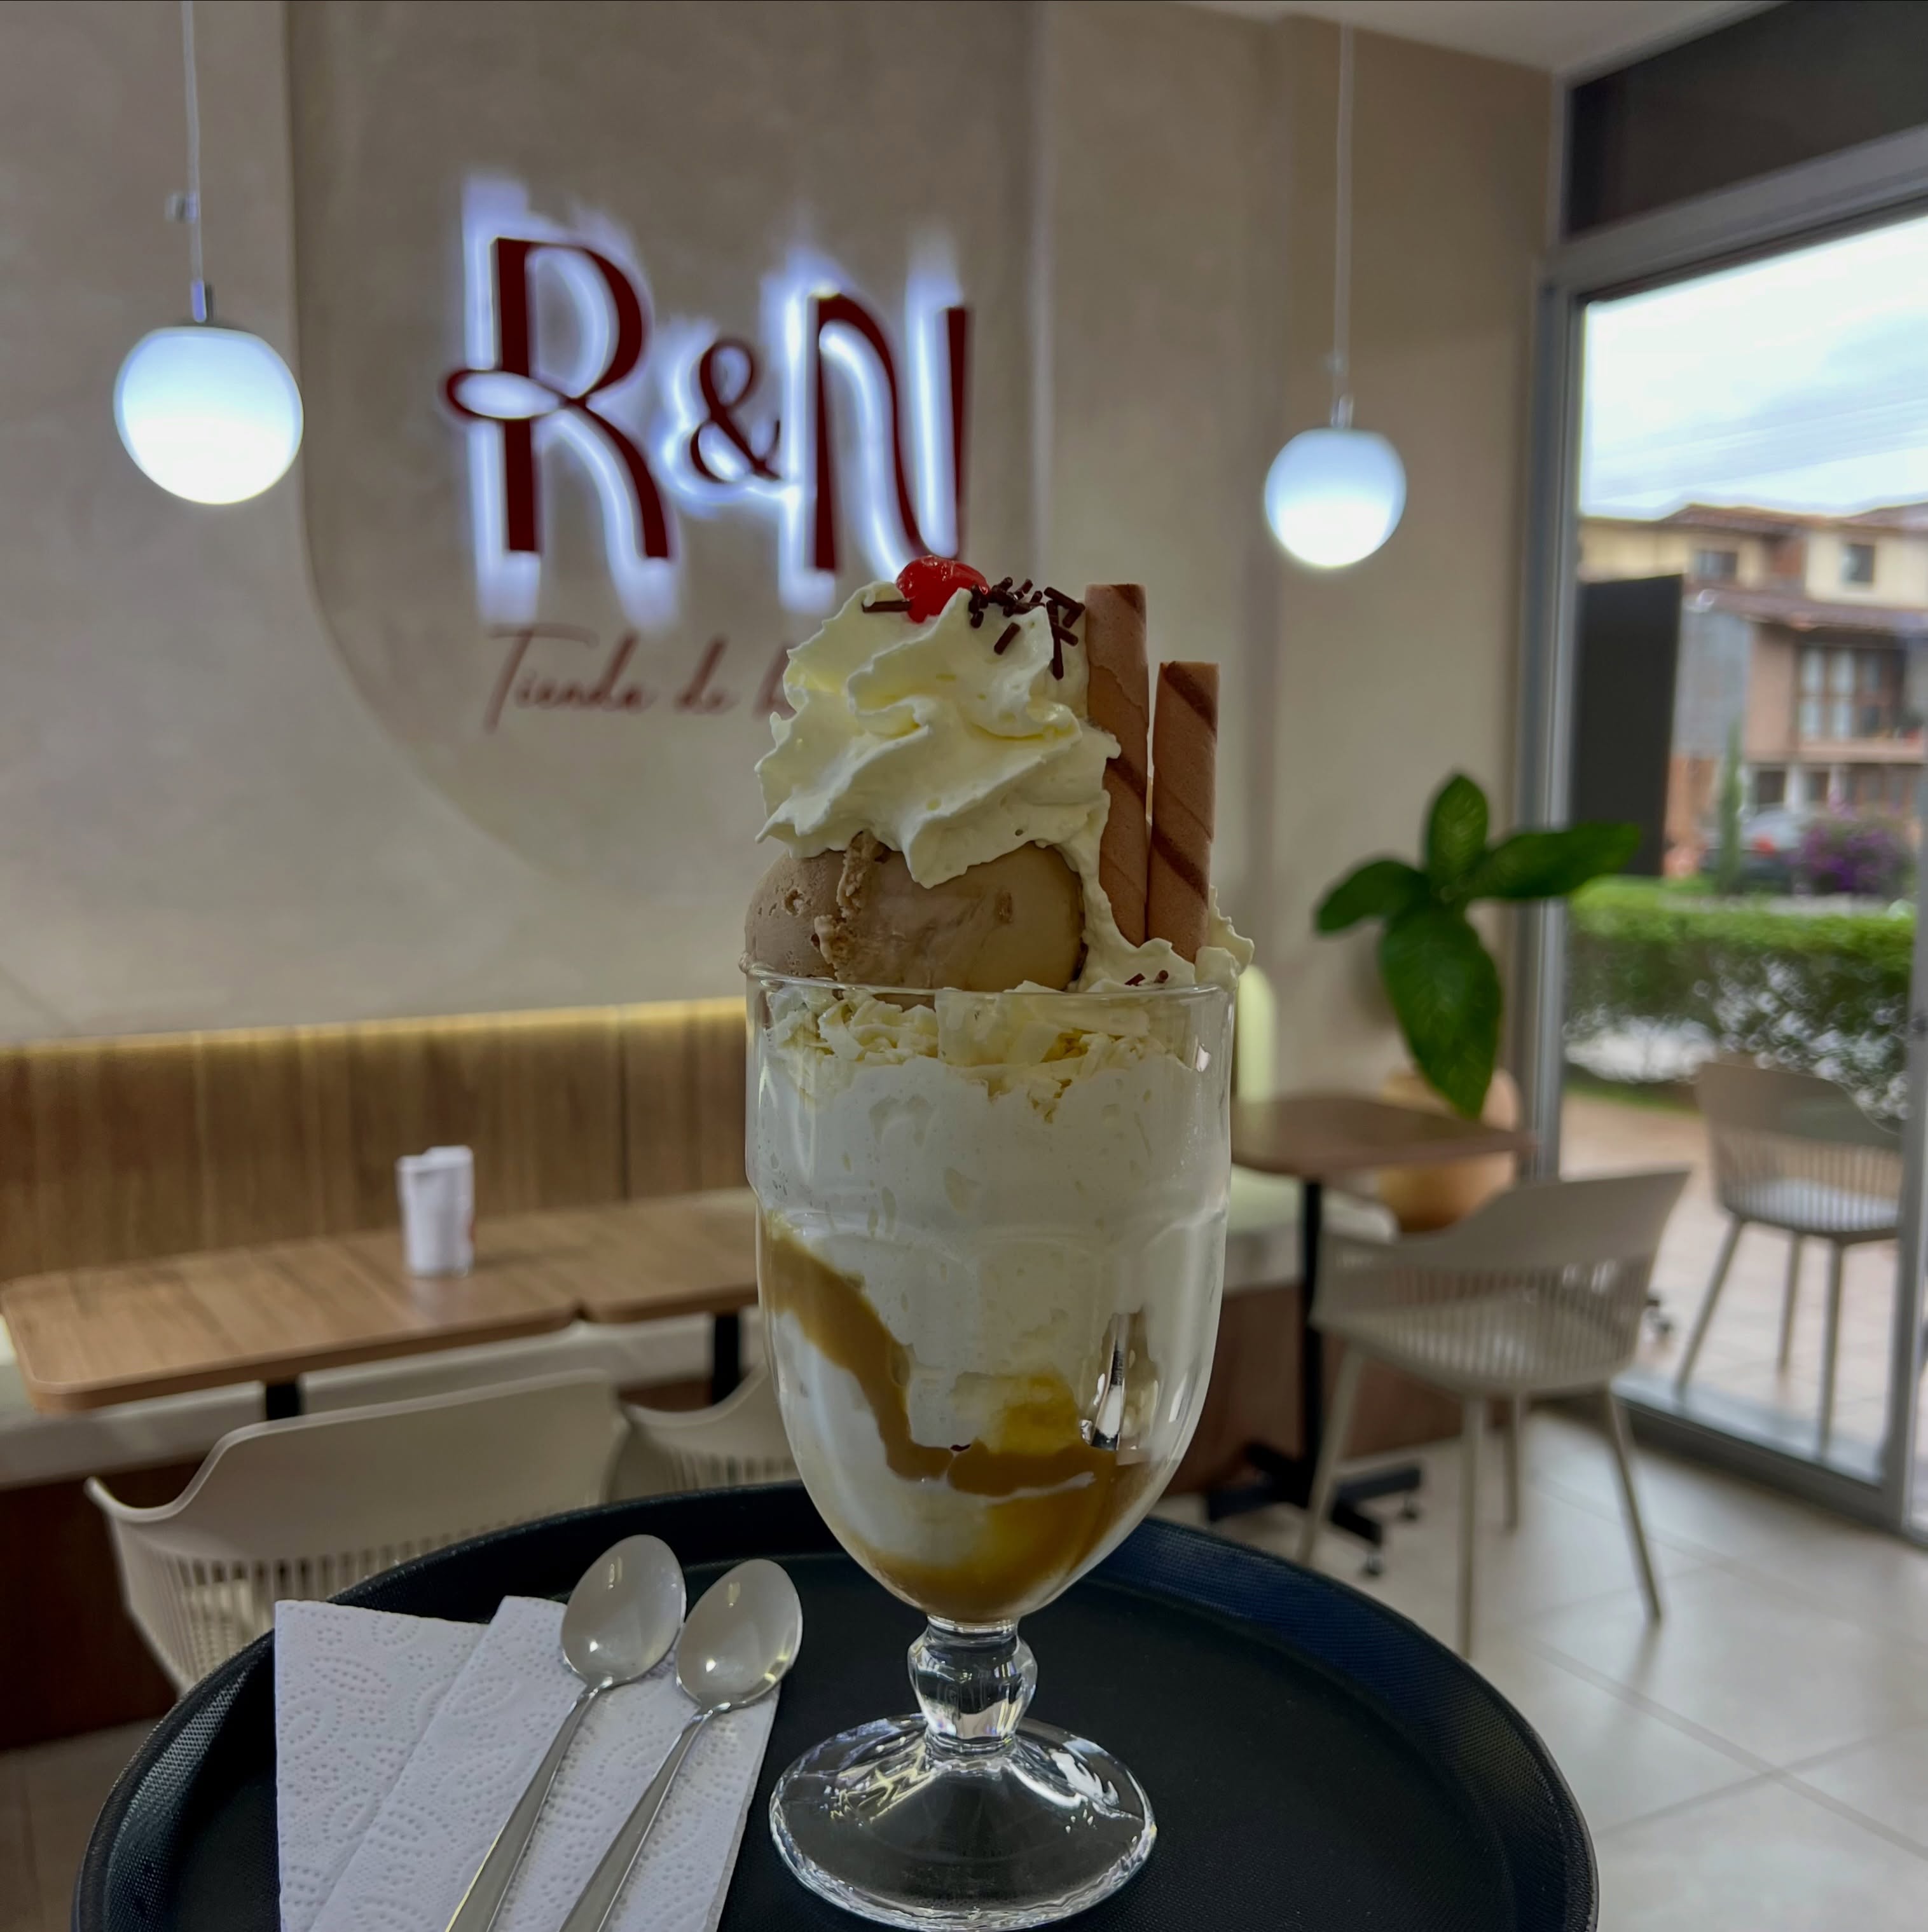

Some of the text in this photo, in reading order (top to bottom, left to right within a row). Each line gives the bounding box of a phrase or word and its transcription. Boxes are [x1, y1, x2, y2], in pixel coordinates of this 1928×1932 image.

[443, 237, 969, 572] R&N
[487, 623, 651, 731] Tienda
[676, 633, 734, 713] de
